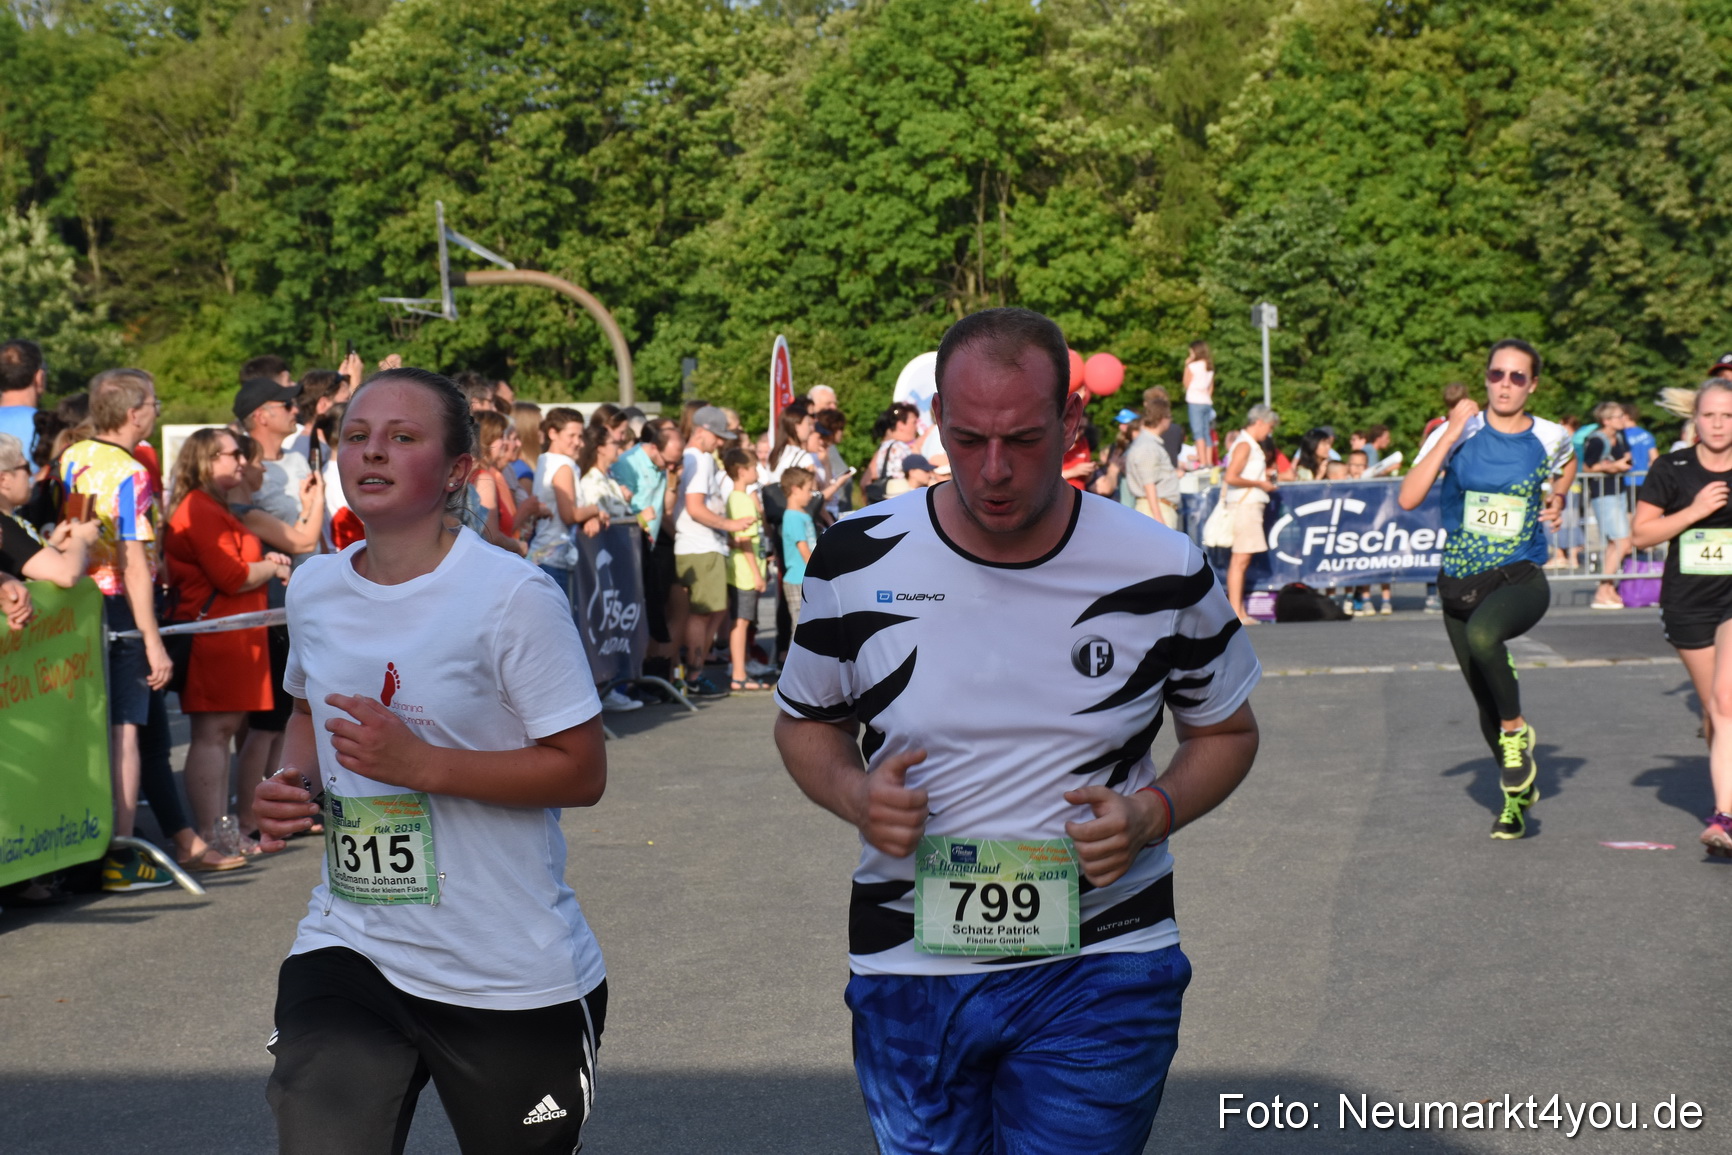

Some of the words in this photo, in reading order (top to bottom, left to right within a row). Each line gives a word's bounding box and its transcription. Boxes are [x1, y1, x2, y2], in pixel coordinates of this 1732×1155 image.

[1477, 508, 1508, 527] 201
[1700, 545, 1723, 561] 44
[394, 822, 421, 834] 2019
[331, 831, 415, 874] 1315
[372, 876, 417, 886] Johanna
[1038, 869, 1068, 881] 2019
[356, 885, 370, 893] Haus
[949, 881, 1041, 923] 799
[952, 924, 994, 936] Schatz
[997, 924, 1040, 936] Patrick
[966, 936, 997, 944] Fischer
[999, 936, 1025, 944] GmbH
[523, 1109, 567, 1125] adidas
